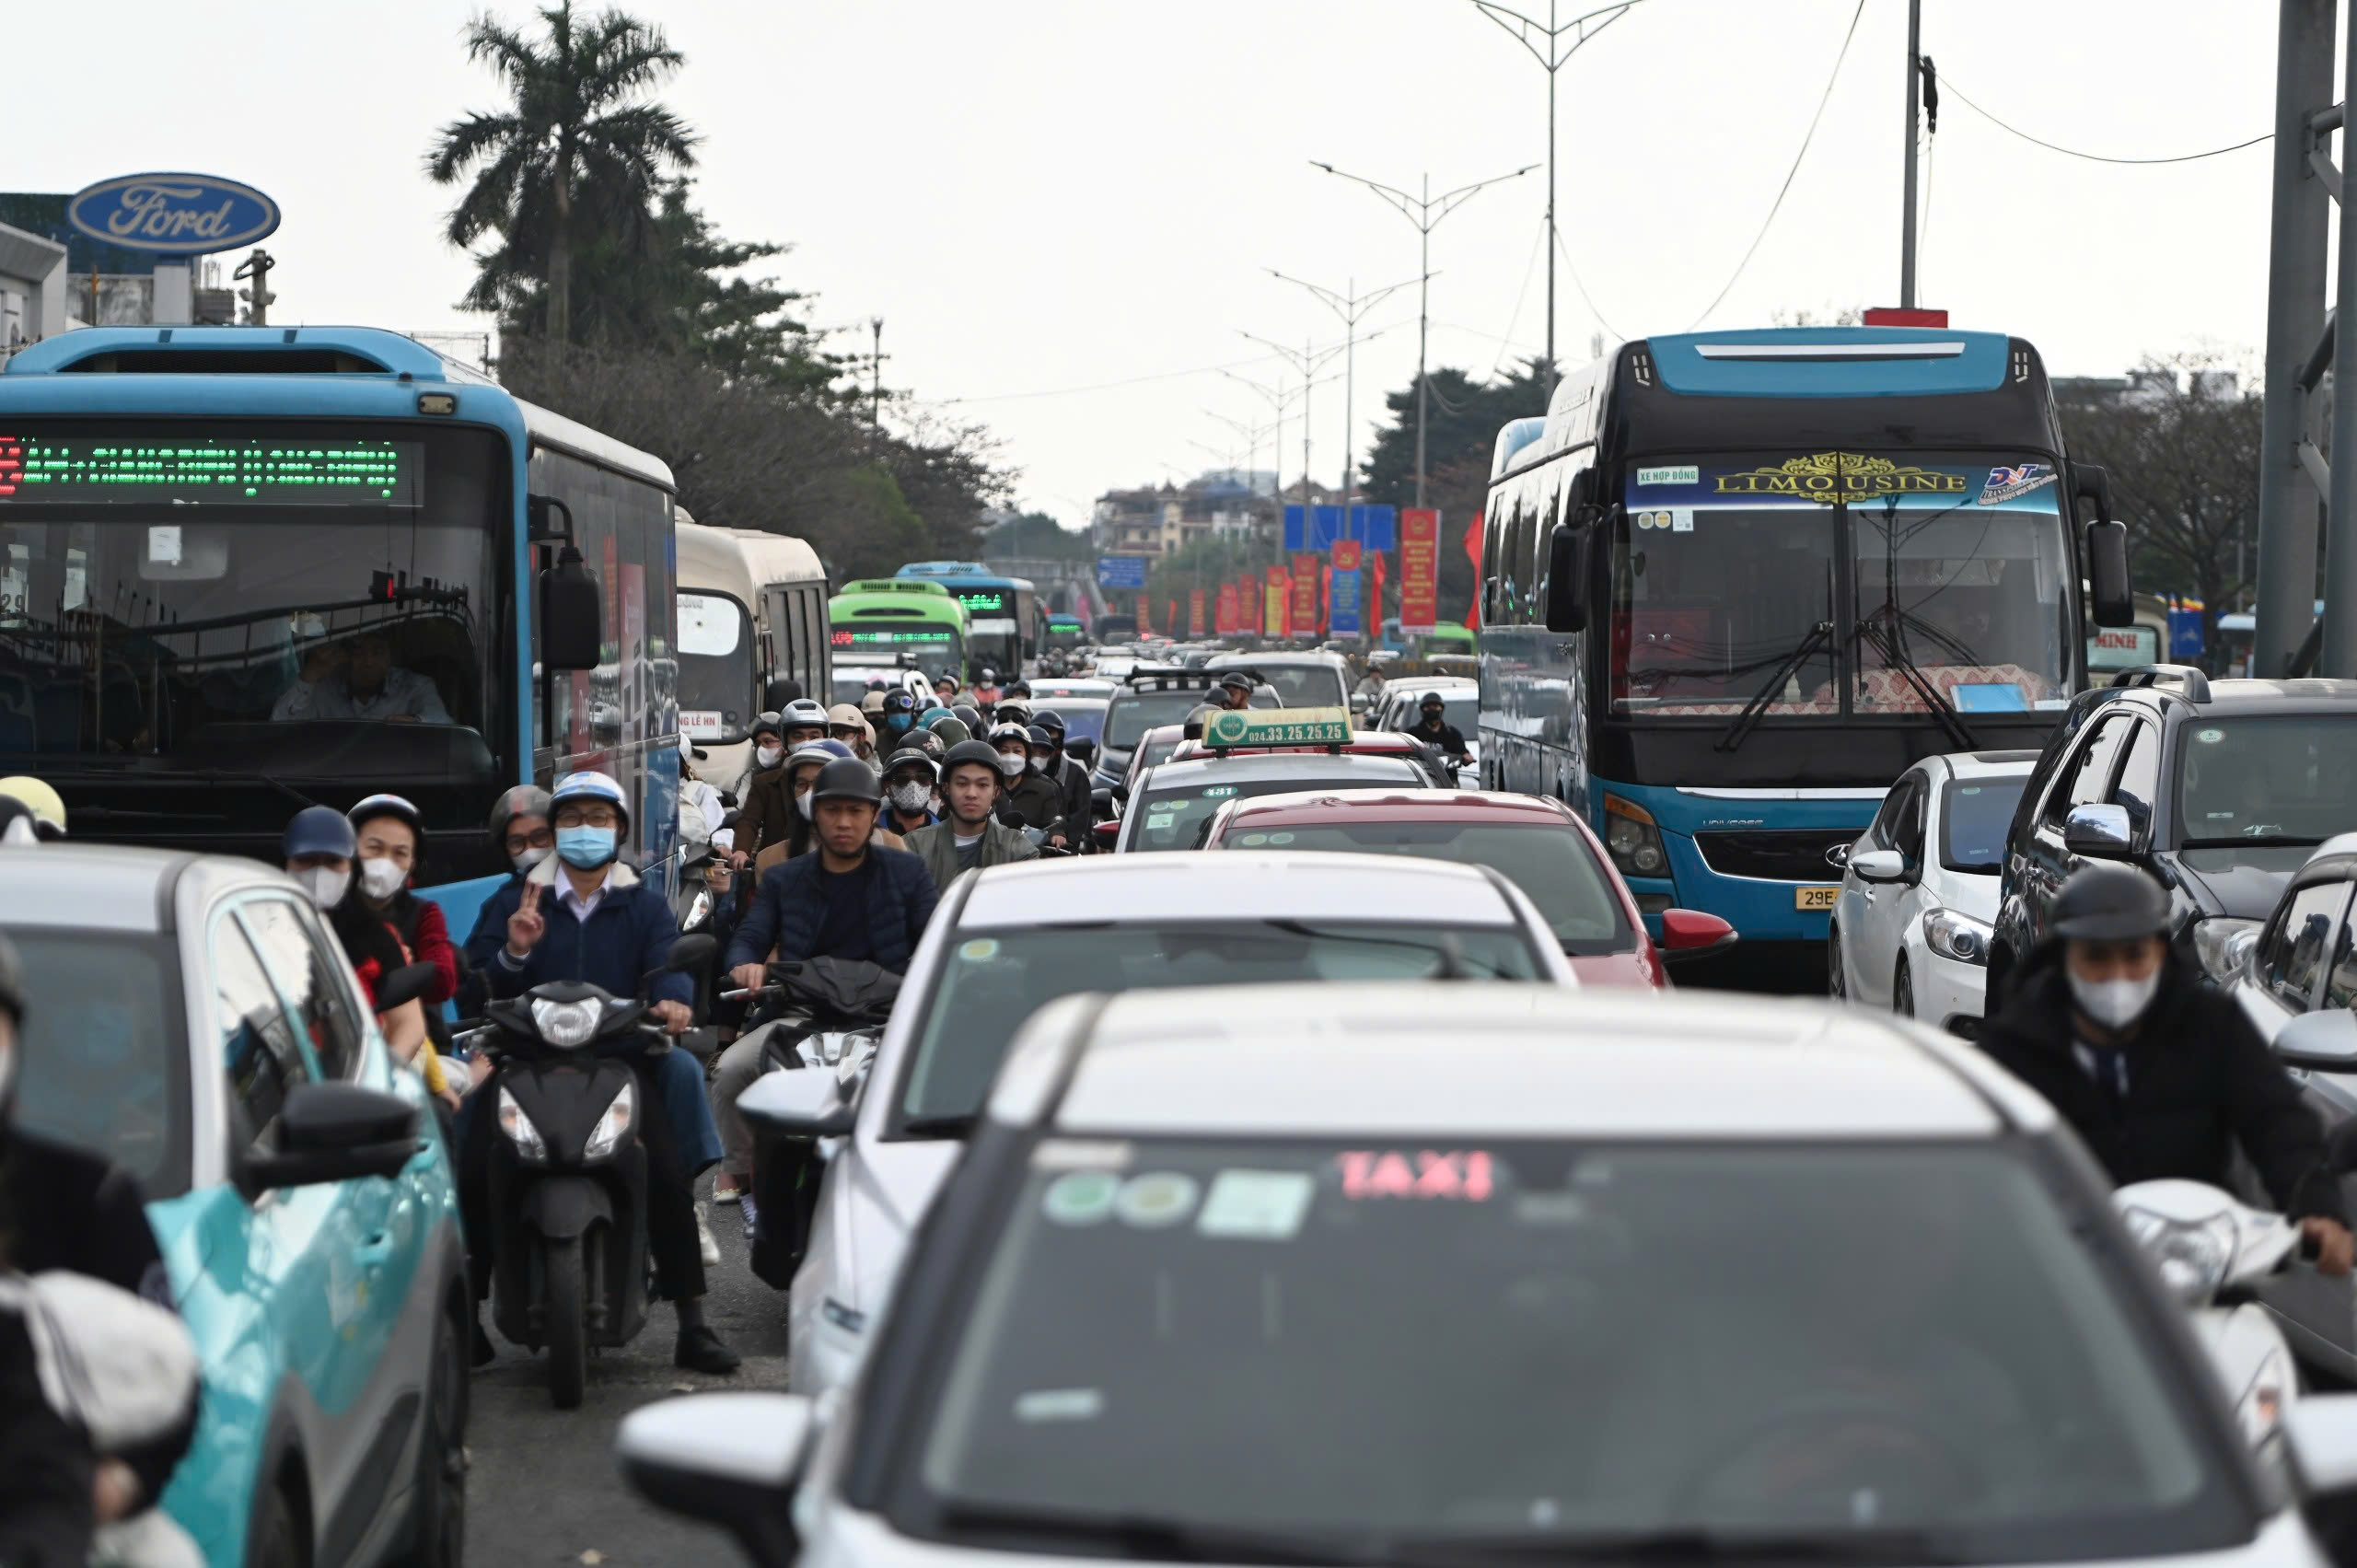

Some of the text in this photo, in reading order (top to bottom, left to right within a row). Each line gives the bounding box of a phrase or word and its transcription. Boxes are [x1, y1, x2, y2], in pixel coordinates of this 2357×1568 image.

[108, 185, 234, 237] Ford
[1640, 472, 1651, 482] XE
[1716, 475, 1967, 491] LIMOUSINE
[1338, 1150, 1493, 1201] TAXI
